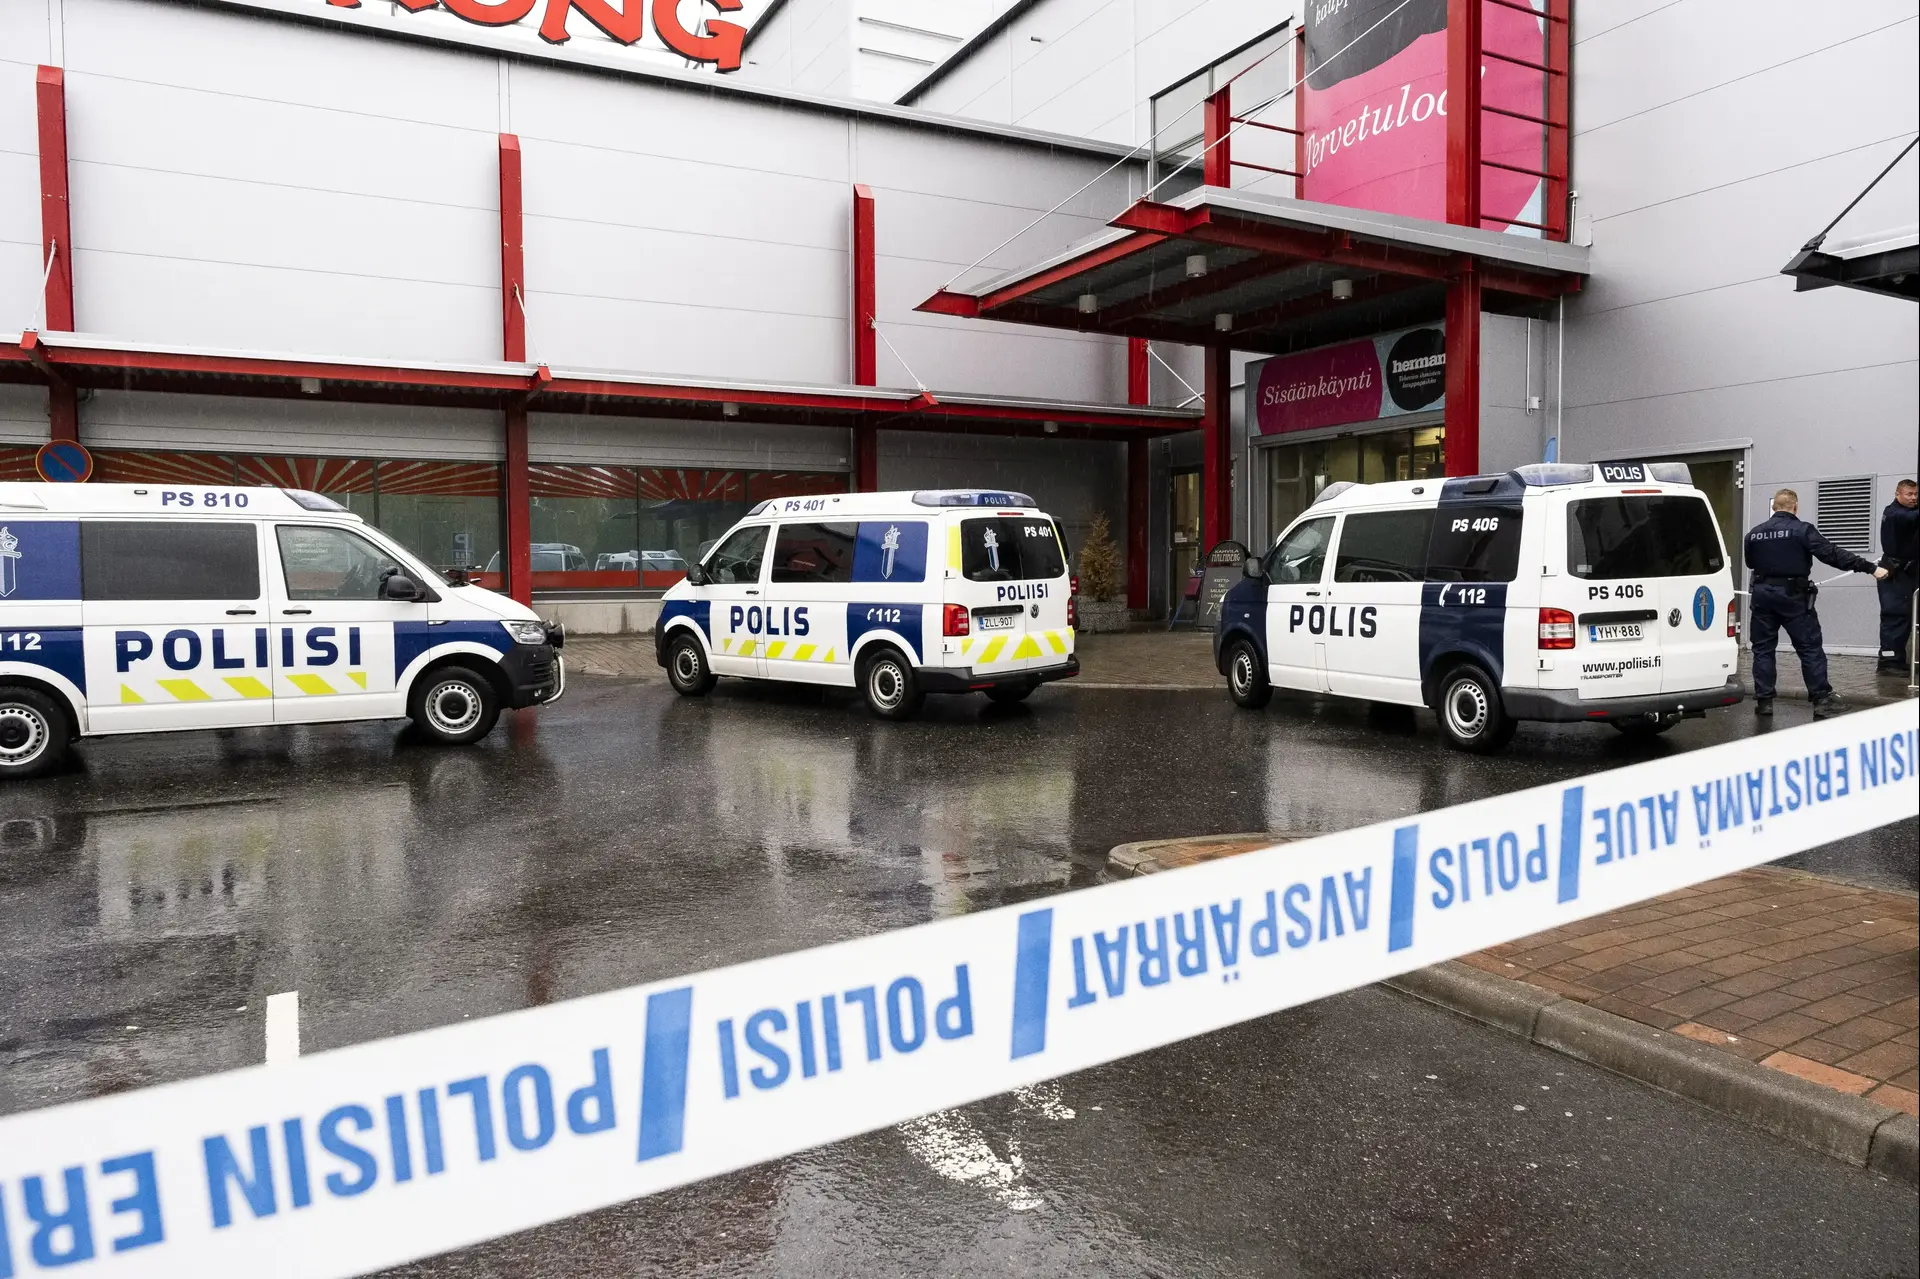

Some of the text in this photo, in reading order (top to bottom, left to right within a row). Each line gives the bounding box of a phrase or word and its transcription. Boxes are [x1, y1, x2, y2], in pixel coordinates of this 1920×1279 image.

[1263, 367, 1372, 406] Sisäänkäynti
[1604, 467, 1642, 480] POLIS
[162, 491, 249, 508] PS 810
[785, 499, 825, 512] PS 401
[984, 496, 1007, 505] POLIS
[1024, 526, 1053, 537] PS 401
[1451, 517, 1499, 532] PS 406
[1751, 530, 1789, 541] POLIISI
[997, 583, 1048, 601] POLIISI
[1458, 588, 1486, 604] 112
[1588, 584, 1644, 600] PS 406
[730, 605, 809, 636] POLIS
[876, 608, 901, 623] 112
[984, 617, 1013, 628] ZLL-907
[1289, 604, 1377, 638] POLIS
[1598, 625, 1641, 639] YHY-888
[116, 626, 362, 672] POLIISI
[1583, 656, 1661, 673] www.poliisi.fi
[1692, 747, 1850, 849] ERISTÄMÄ
[1593, 790, 1680, 865] ALUE
[1428, 824, 1549, 910] POLIS
[1067, 866, 1373, 1010] AVSPÄRRAT
[716, 963, 976, 1101] POLIISI
[202, 1047, 618, 1230] POLIISIN
